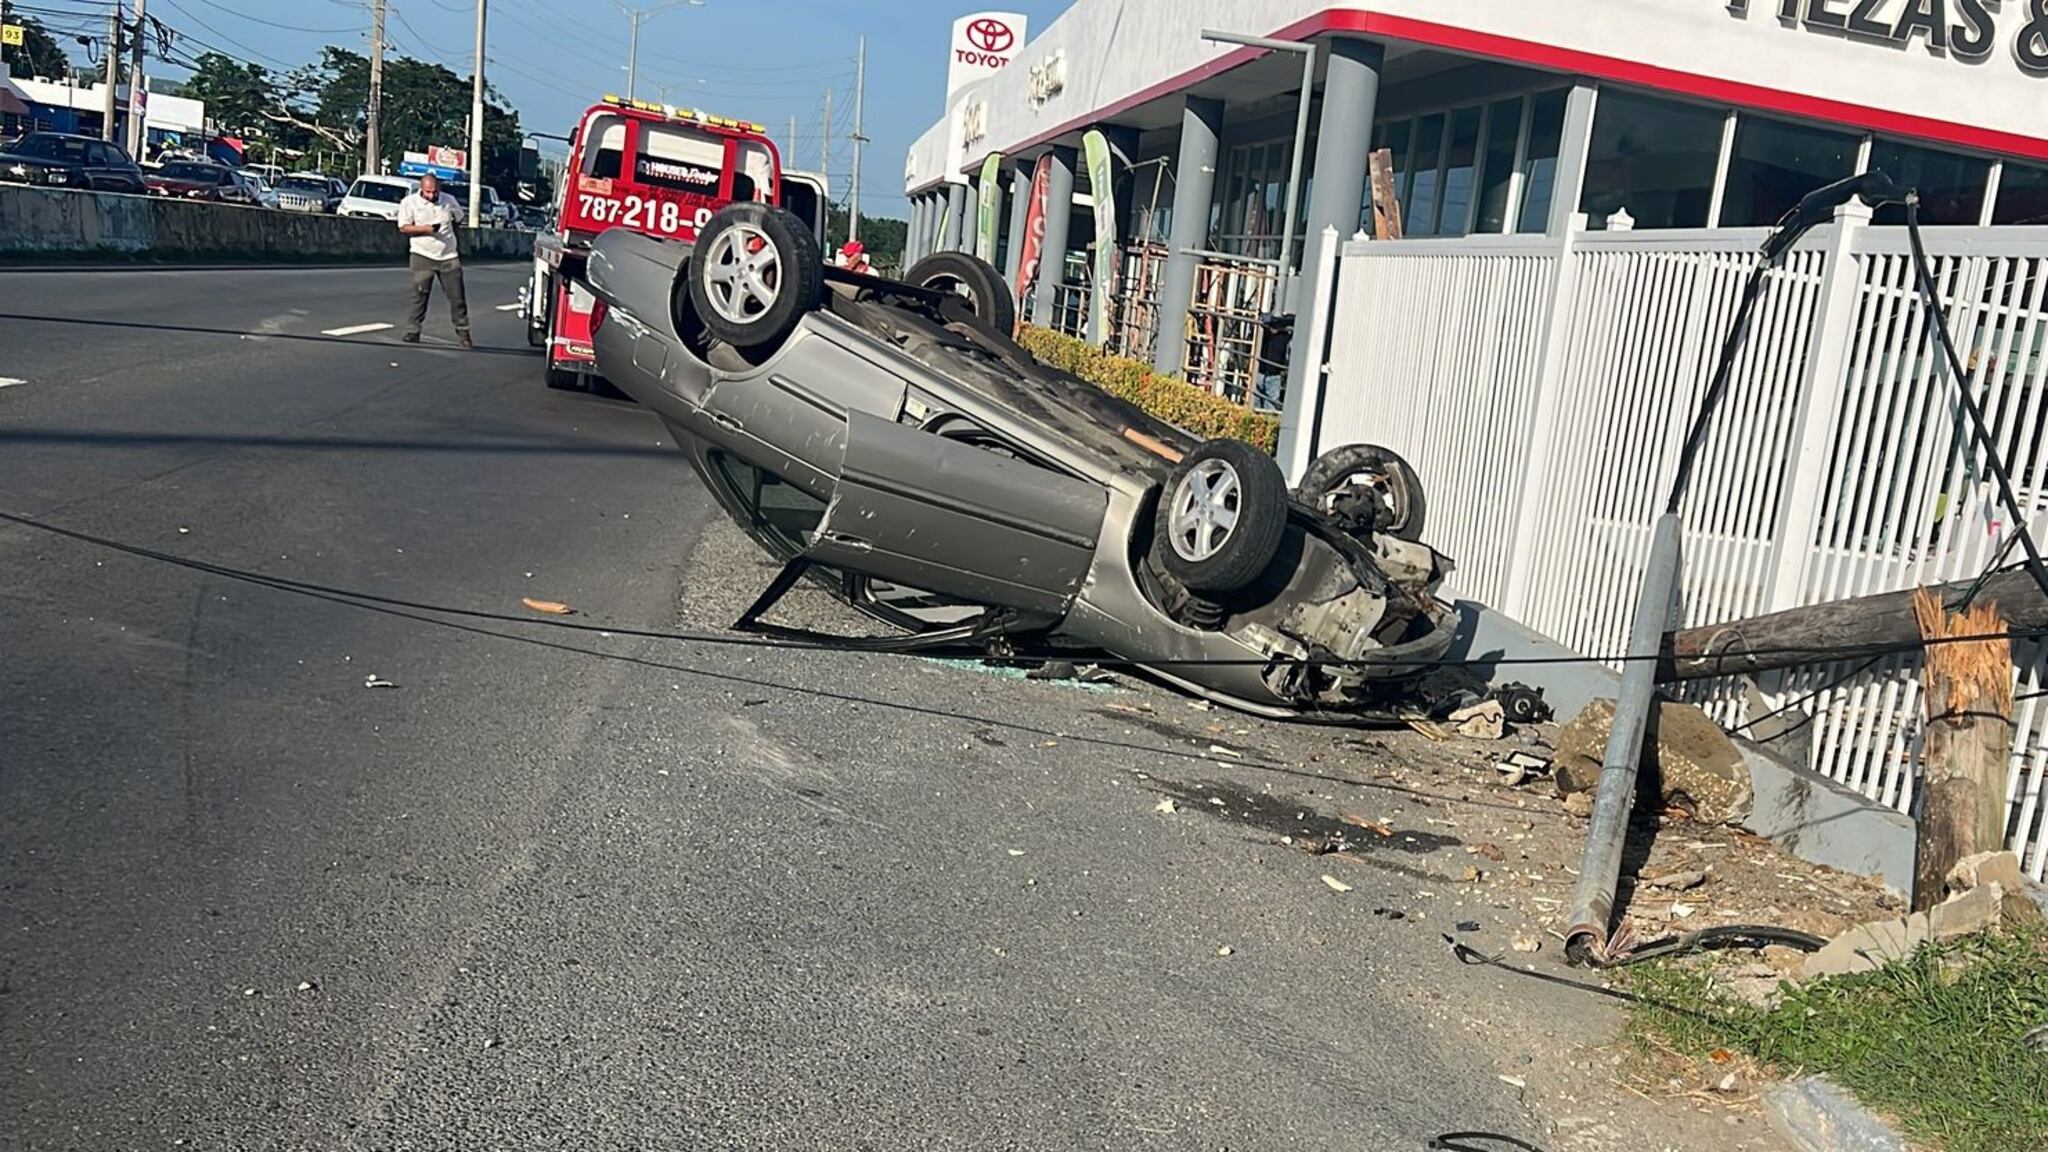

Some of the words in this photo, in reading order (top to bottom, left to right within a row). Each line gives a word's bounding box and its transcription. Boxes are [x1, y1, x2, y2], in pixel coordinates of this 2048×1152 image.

[1726, 0, 2000, 64] ZAS
[956, 49, 1009, 68] TOYOT
[579, 194, 713, 237] 787-218-9
